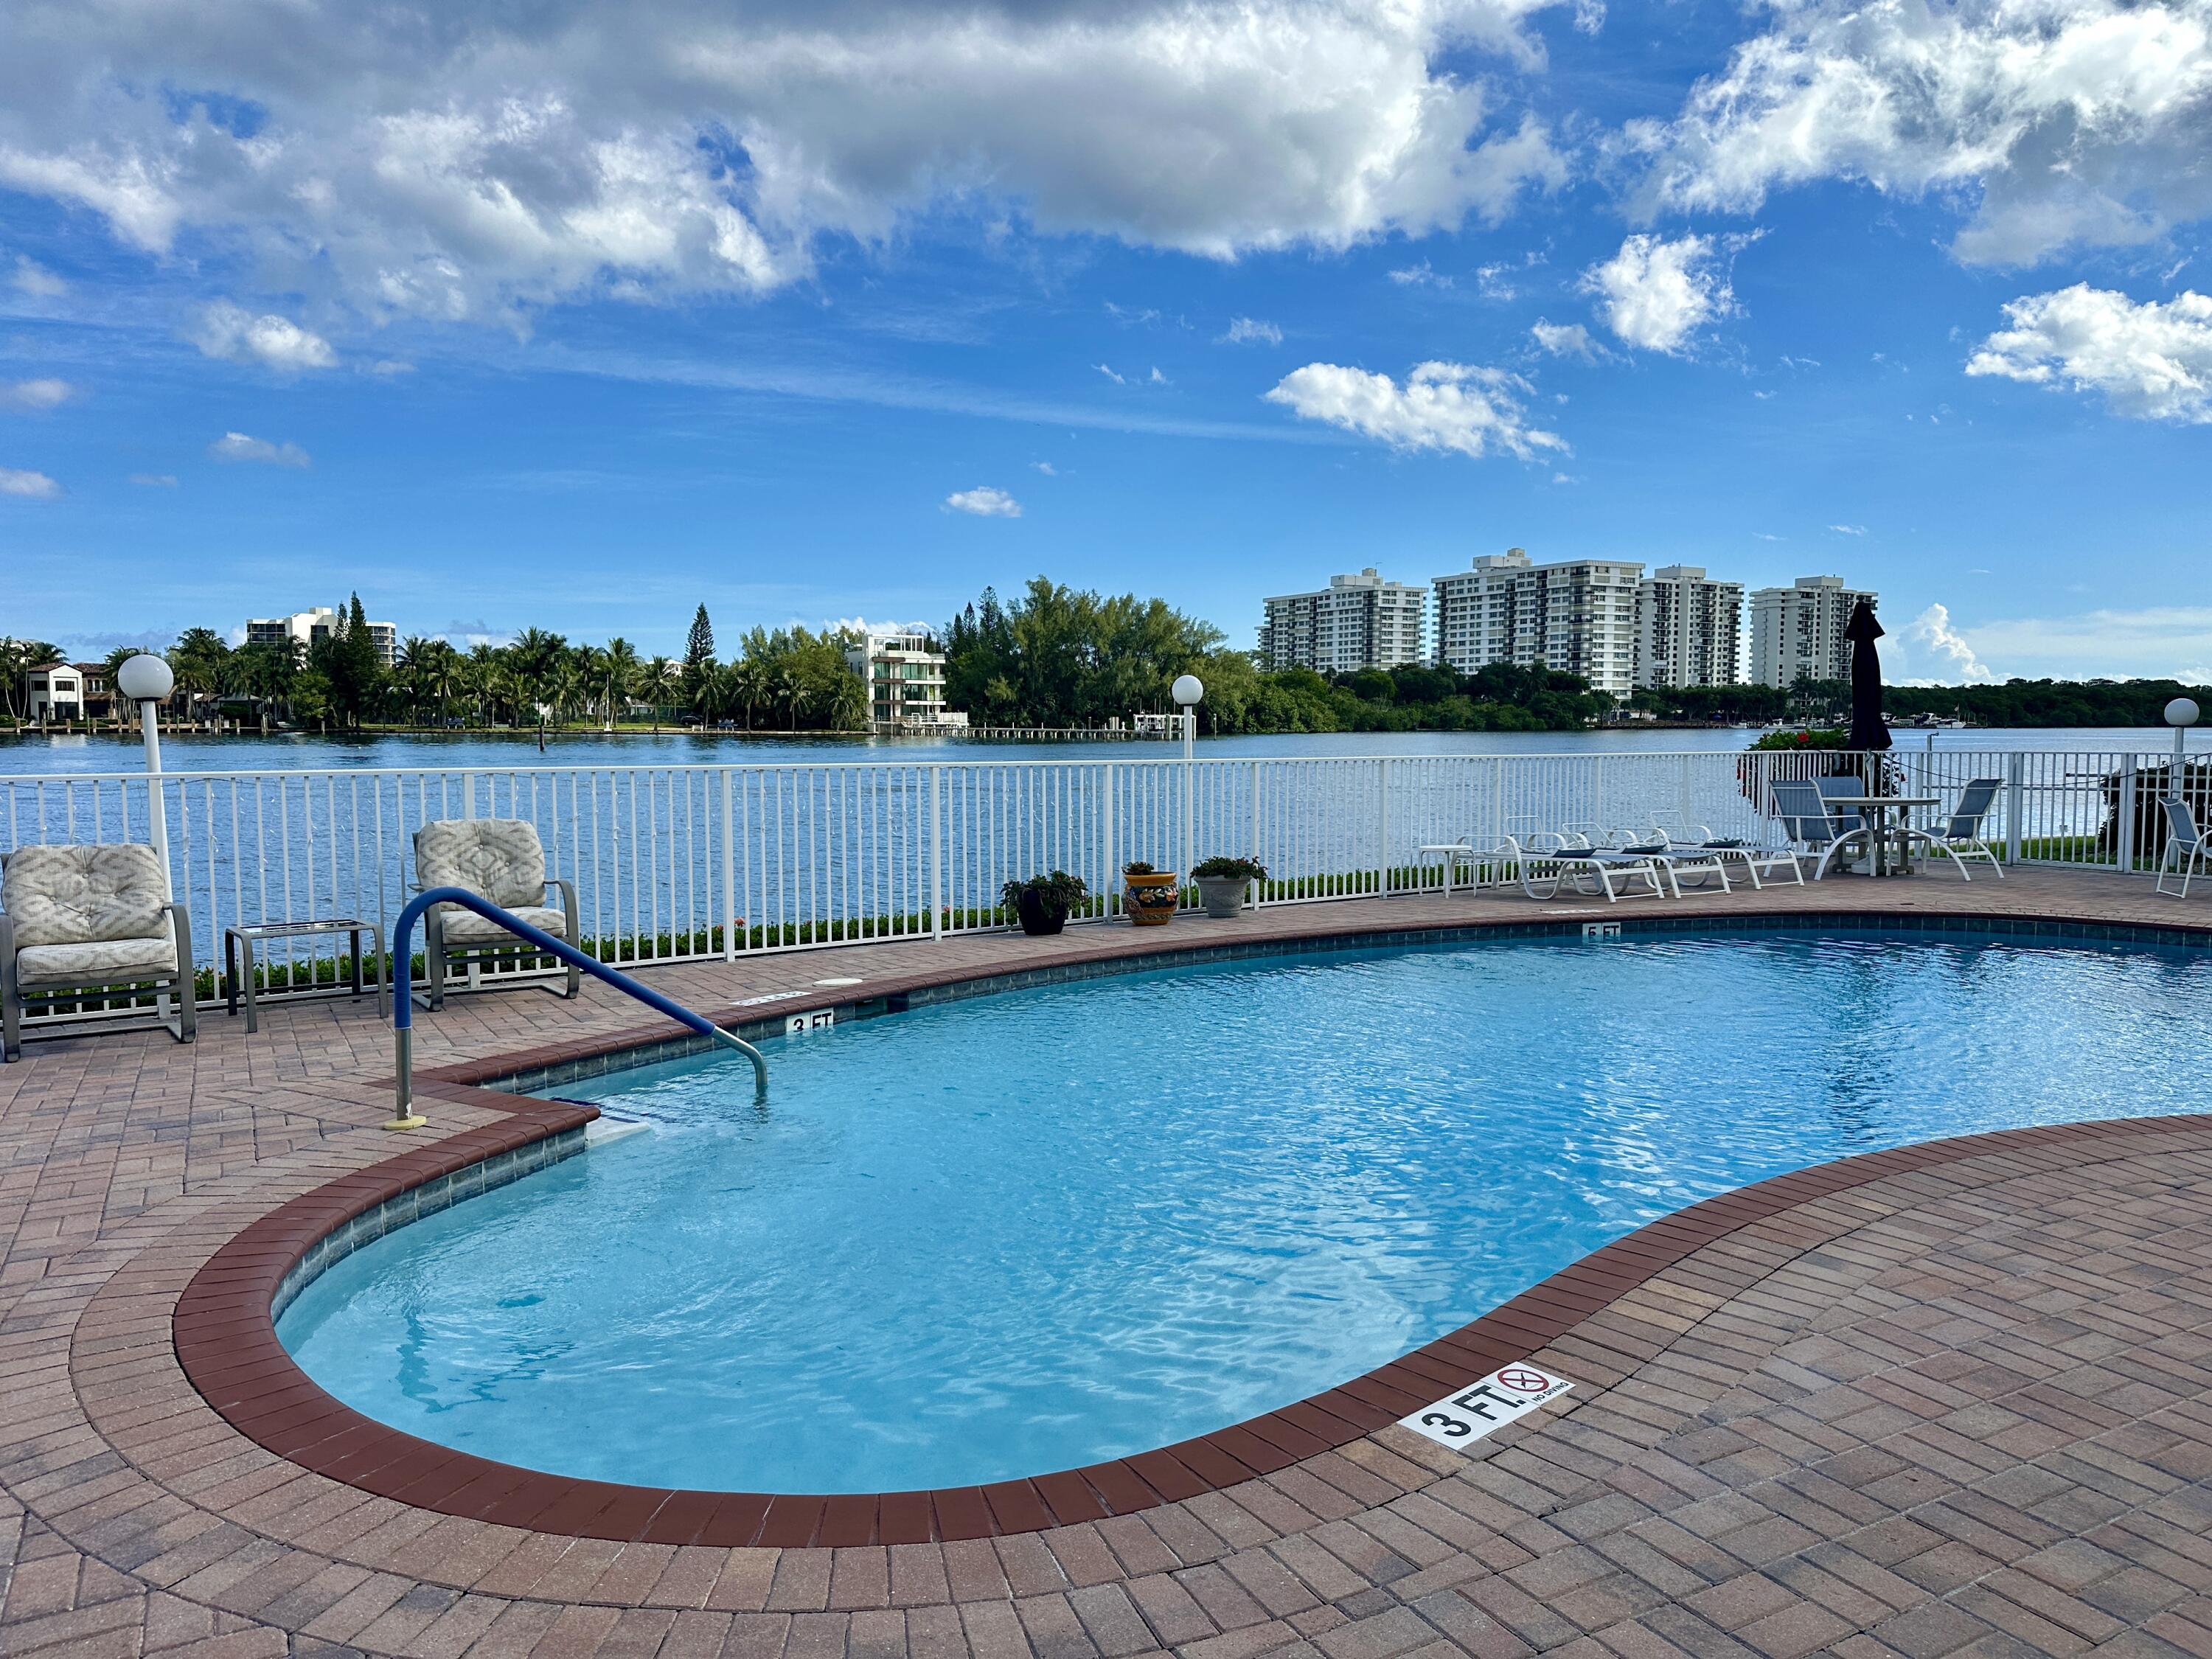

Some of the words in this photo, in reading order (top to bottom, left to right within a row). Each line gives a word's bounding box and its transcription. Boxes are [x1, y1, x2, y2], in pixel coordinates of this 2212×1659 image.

[1588, 926, 1596, 936] 5
[1603, 925, 1619, 936] FT
[793, 1018, 804, 1032] 3
[812, 1012, 832, 1029] FT
[1531, 1394, 1545, 1402] NO
[1543, 1382, 1569, 1396] DIVING
[1422, 1413, 1472, 1437] 3
[1451, 1385, 1526, 1421] FT.
